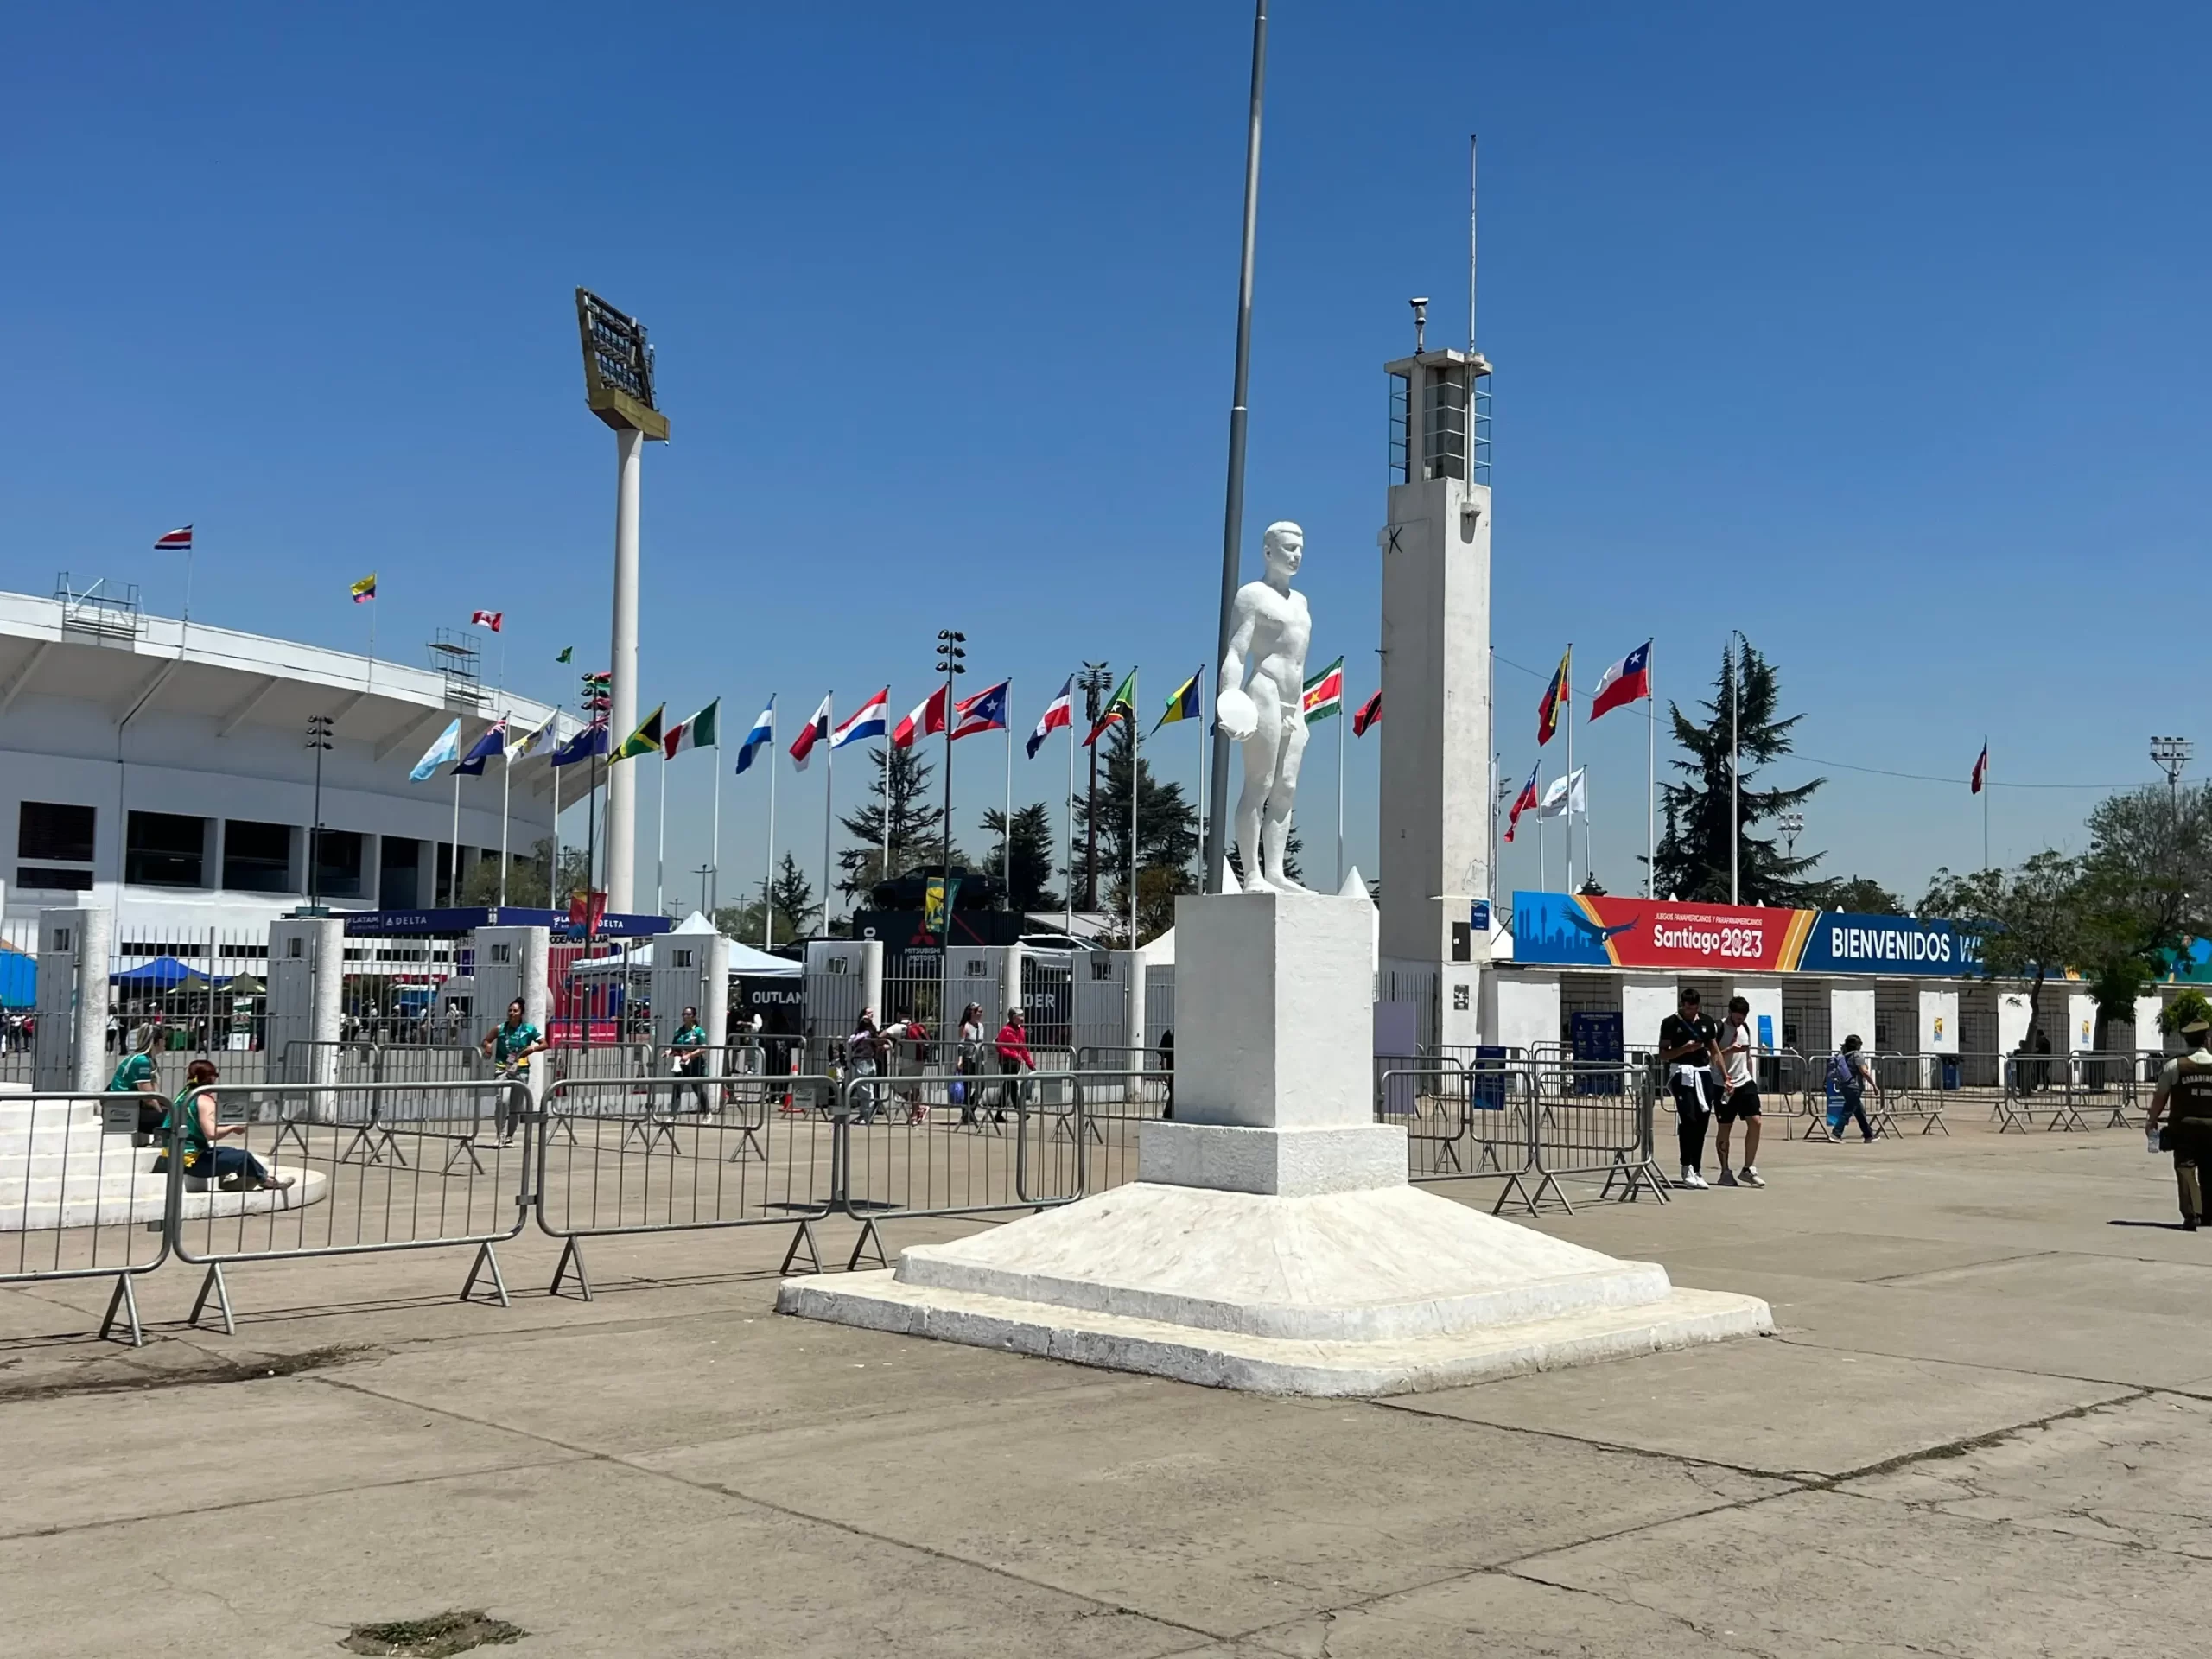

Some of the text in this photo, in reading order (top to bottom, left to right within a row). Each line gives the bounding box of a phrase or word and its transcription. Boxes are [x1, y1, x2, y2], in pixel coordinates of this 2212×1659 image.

[395, 916, 427, 925] DELTA
[597, 919, 624, 929] DELTA
[1655, 912, 1674, 921] JUEGOS
[1674, 913, 1712, 924] PANAMERICANOS
[1716, 916, 1763, 926] PARAPANAMERICANOS
[1653, 924, 1763, 958] Santiago 2023
[1831, 927, 1950, 962] BIENVENIDOS
[752, 991, 808, 1004] OUTLAN
